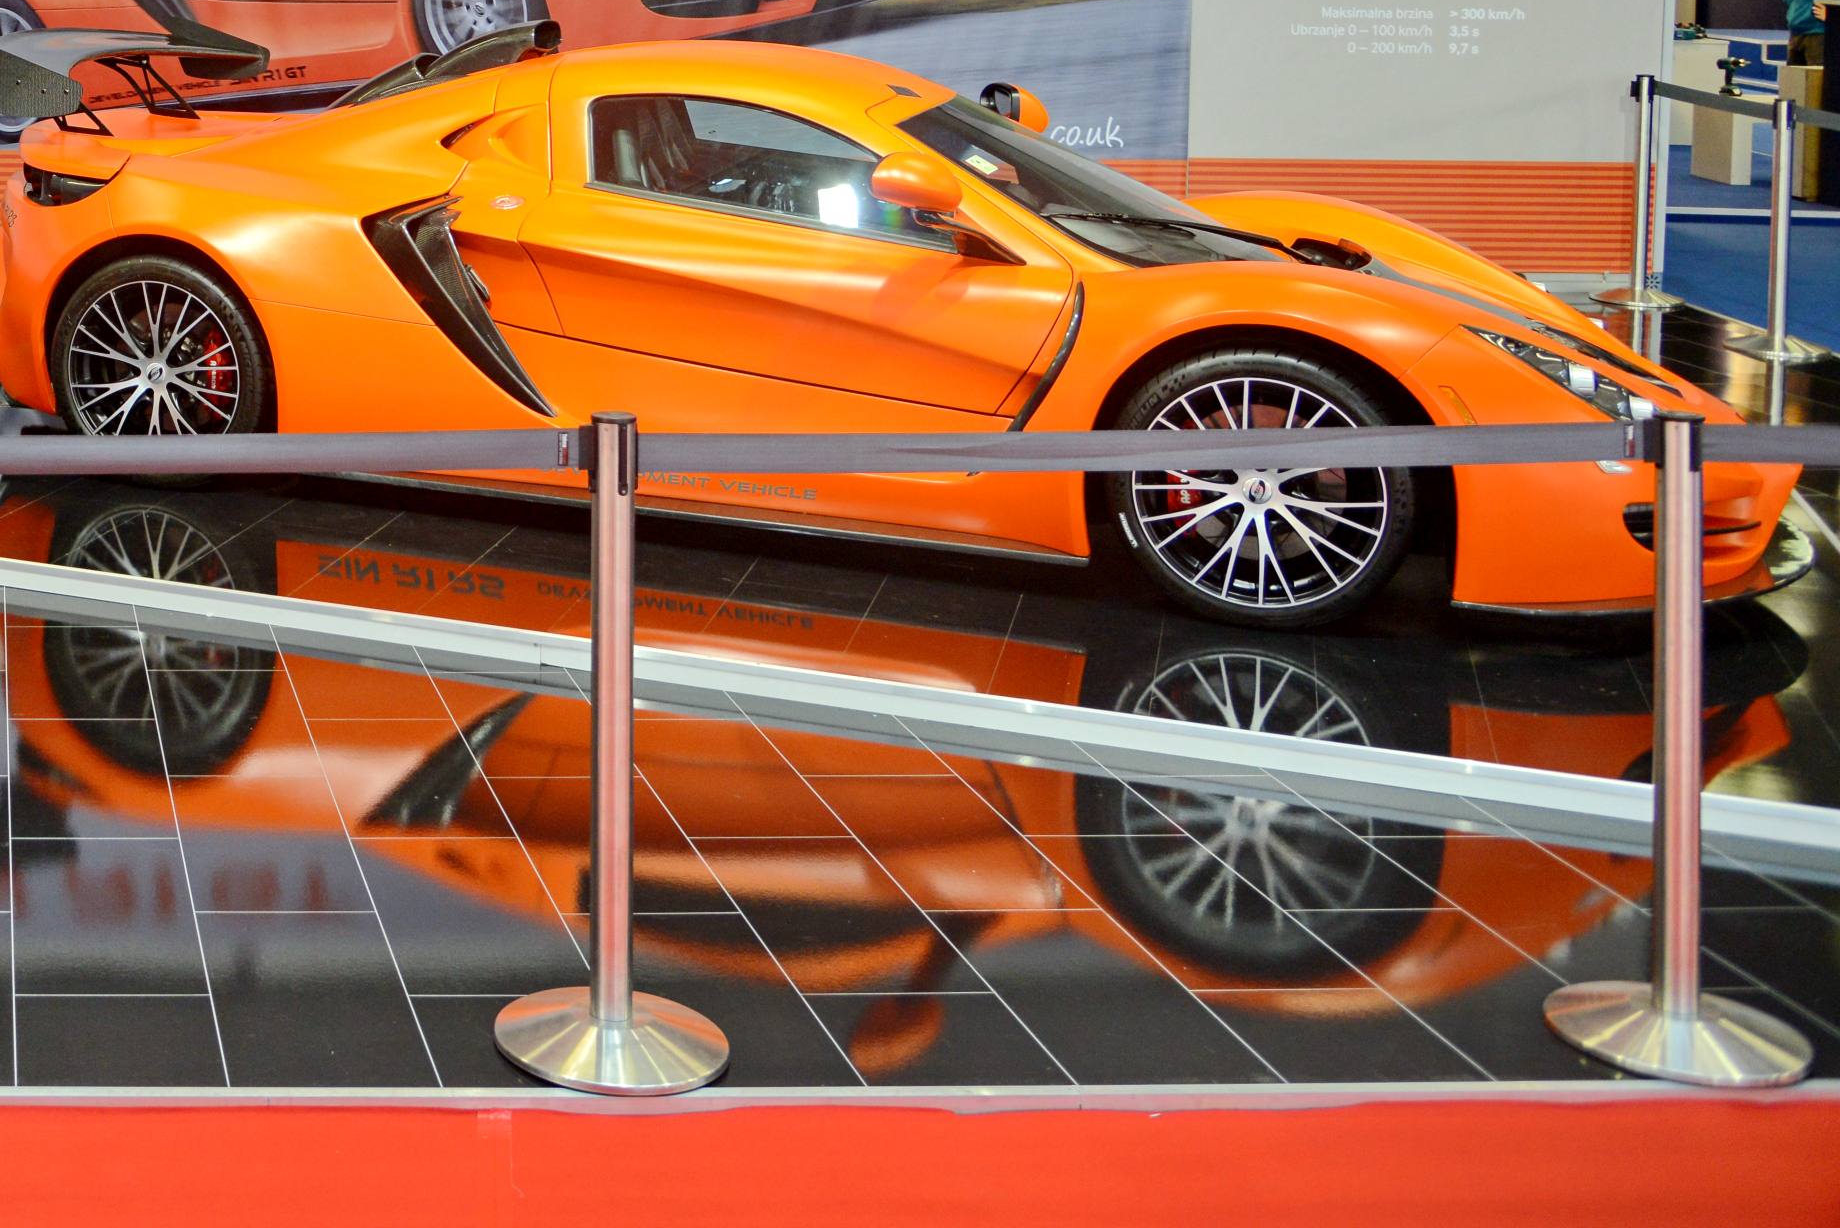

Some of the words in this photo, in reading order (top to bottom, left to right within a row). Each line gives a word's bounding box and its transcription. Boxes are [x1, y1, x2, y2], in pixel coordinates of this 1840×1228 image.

[1321, 6, 1393, 20] Maksimalna
[1396, 6, 1434, 20] brzina
[1461, 8, 1486, 20] 300
[1488, 7, 1526, 21] km/h
[1291, 24, 1345, 38] Ubrzanje
[1348, 24, 1356, 36] 0
[1371, 24, 1396, 37] 100
[1398, 24, 1433, 37] km/h
[1347, 41, 1356, 53] 0
[1371, 41, 1396, 54] 200
[1398, 41, 1433, 54] km/h
[286, 66, 307, 79] GT
[1050, 116, 1124, 148] co.uk
[719, 479, 818, 501] VEHICLE
